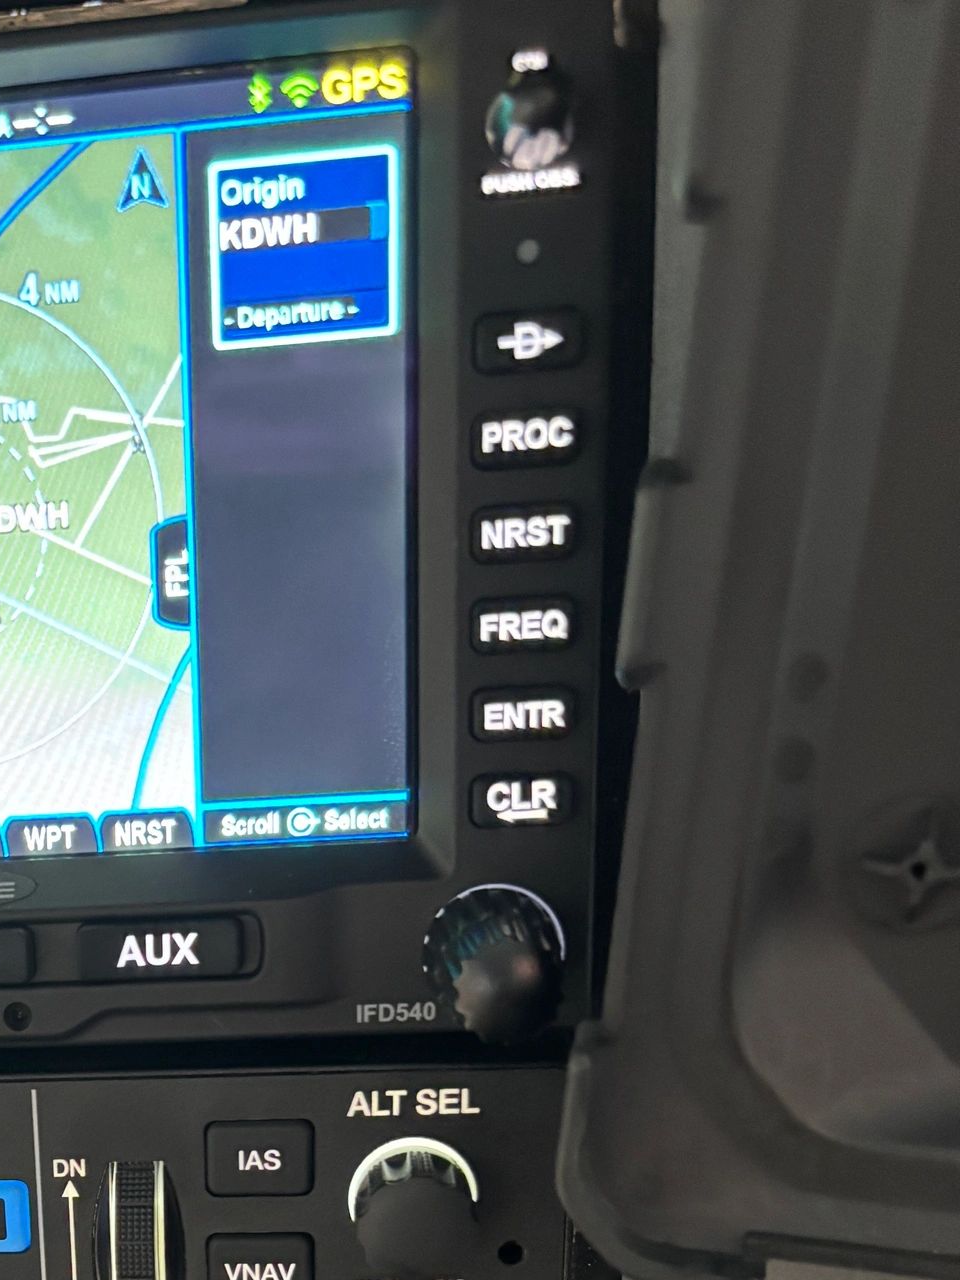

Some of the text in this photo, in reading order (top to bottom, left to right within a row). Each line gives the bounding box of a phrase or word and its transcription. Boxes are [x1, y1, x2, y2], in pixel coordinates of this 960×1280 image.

[322, 63, 406, 105] GPS
[222, 174, 305, 208] Origin
[219, 213, 319, 252] KDWH
[237, 298, 344, 331] Departure
[481, 416, 574, 453] PROC
[481, 514, 571, 550] NRST
[479, 608, 569, 642] FREQ
[483, 700, 566, 731] ENTR
[487, 780, 557, 811] CLR
[24, 824, 77, 851] WPT
[114, 819, 175, 847] NRST
[221, 807, 388, 837] Scroll Select
[117, 932, 200, 968] AUX
[356, 1002, 436, 1023] IFD540
[347, 1088, 480, 1118] ALT SEL
[53, 1158, 86, 1178] DN
[238, 1150, 281, 1171] IAS
